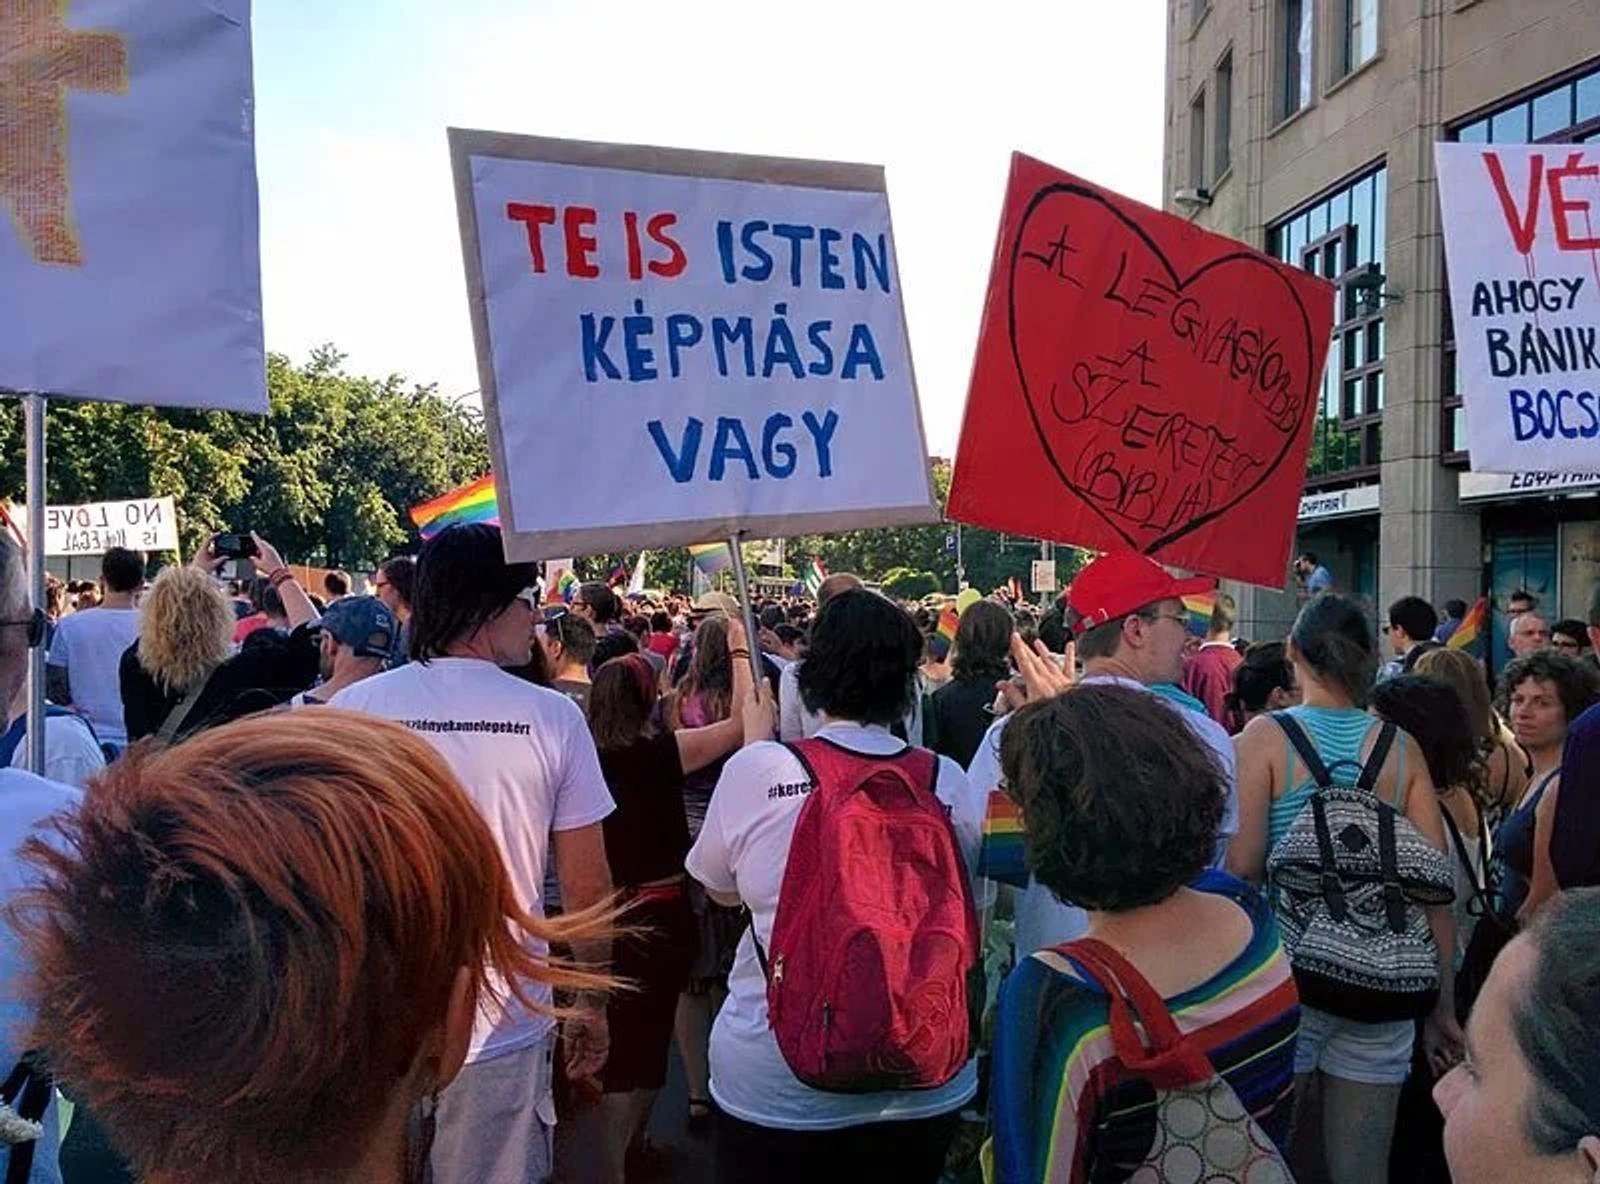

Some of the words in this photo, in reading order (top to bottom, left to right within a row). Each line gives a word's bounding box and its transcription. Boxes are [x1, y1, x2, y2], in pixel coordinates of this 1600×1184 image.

[508, 202, 599, 278] TE
[624, 211, 688, 280] IS
[716, 220, 891, 293] ISTEN
[1022, 224, 1085, 288] A
[1471, 278, 1585, 317] AHOGY
[580, 298, 885, 382] KÉPMÁSA
[1096, 340, 1160, 388] A
[1486, 322, 1600, 378] BÁNIK
[1510, 389, 1600, 441] BOCS
[647, 409, 839, 483] VAGY
